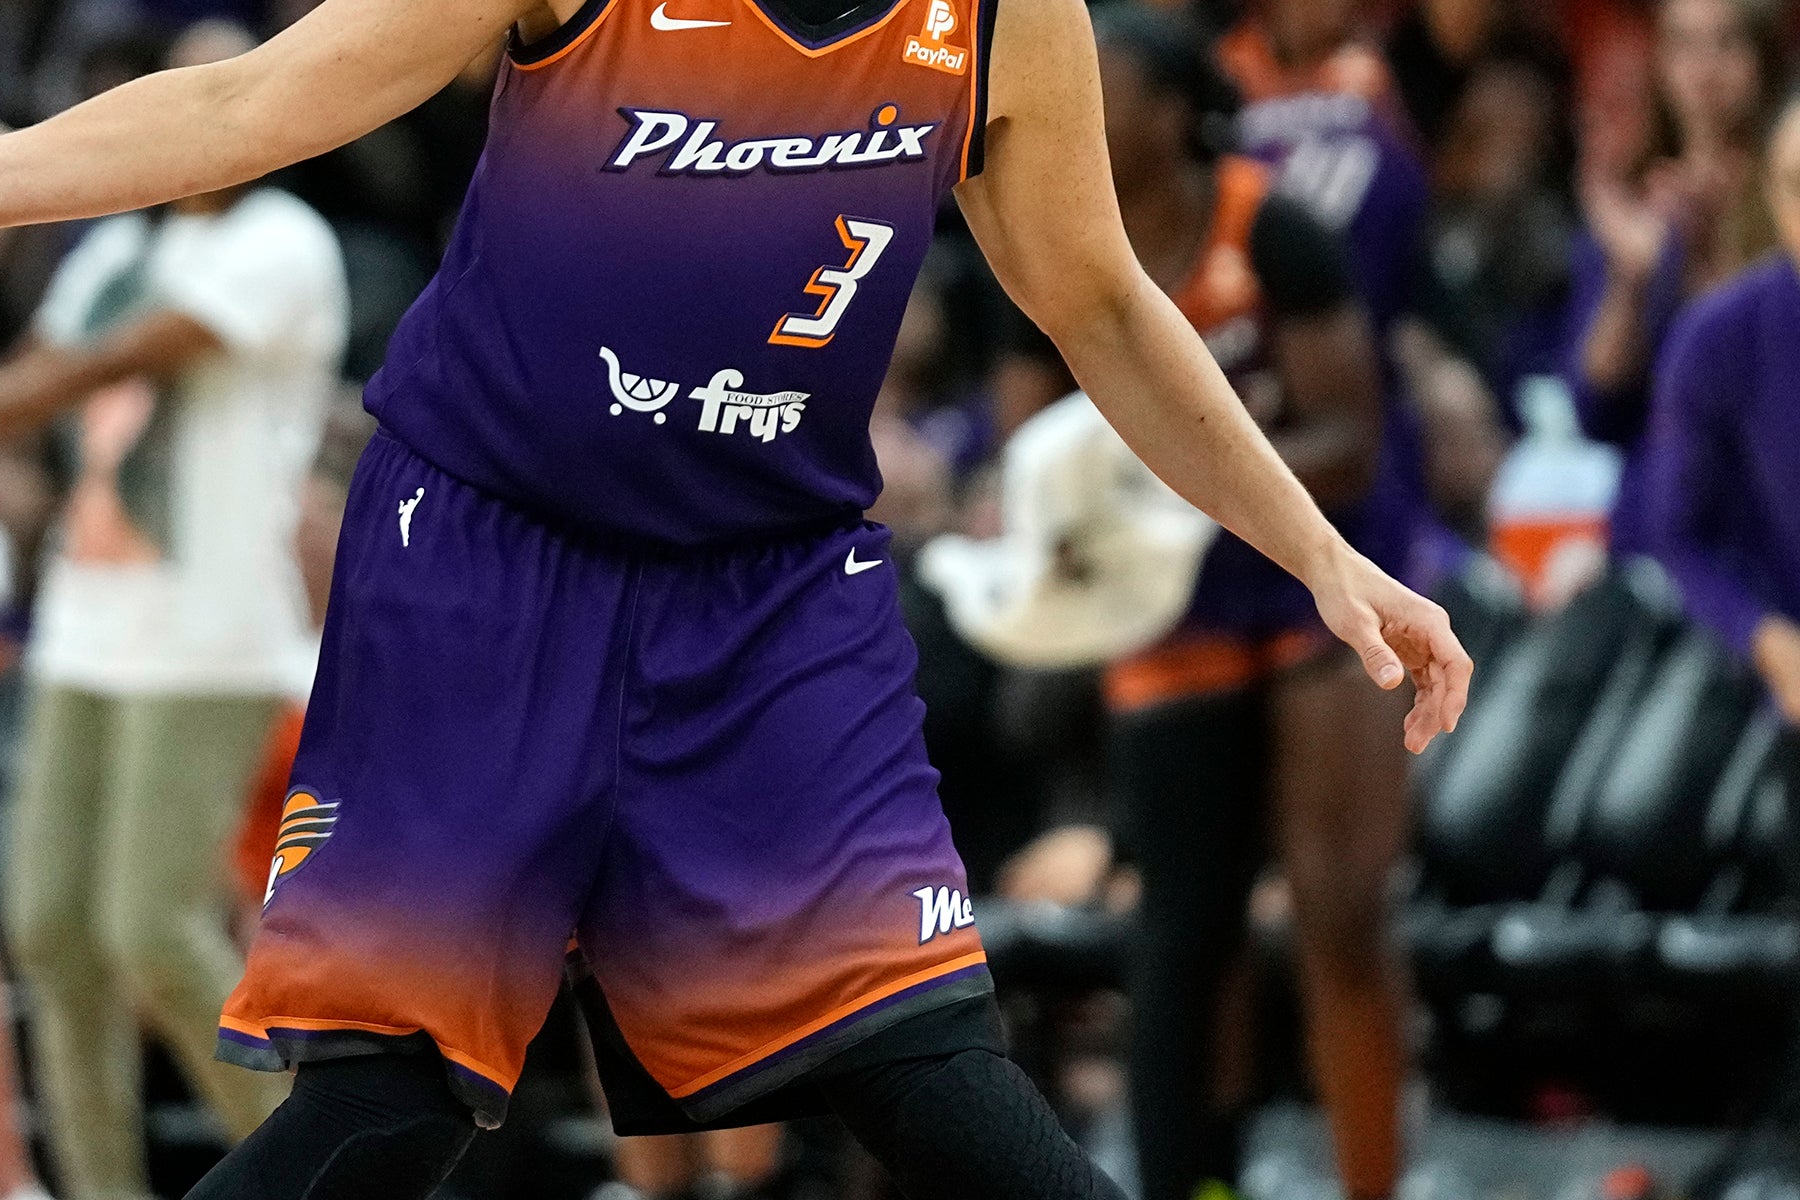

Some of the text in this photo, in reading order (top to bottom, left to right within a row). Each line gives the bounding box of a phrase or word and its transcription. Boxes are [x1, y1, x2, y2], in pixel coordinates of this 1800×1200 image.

[905, 40, 965, 69] PayPal
[610, 104, 937, 173] Phoenix
[768, 214, 895, 348] 3
[688, 368, 808, 443] fry's
[726, 392, 763, 405] FOOD
